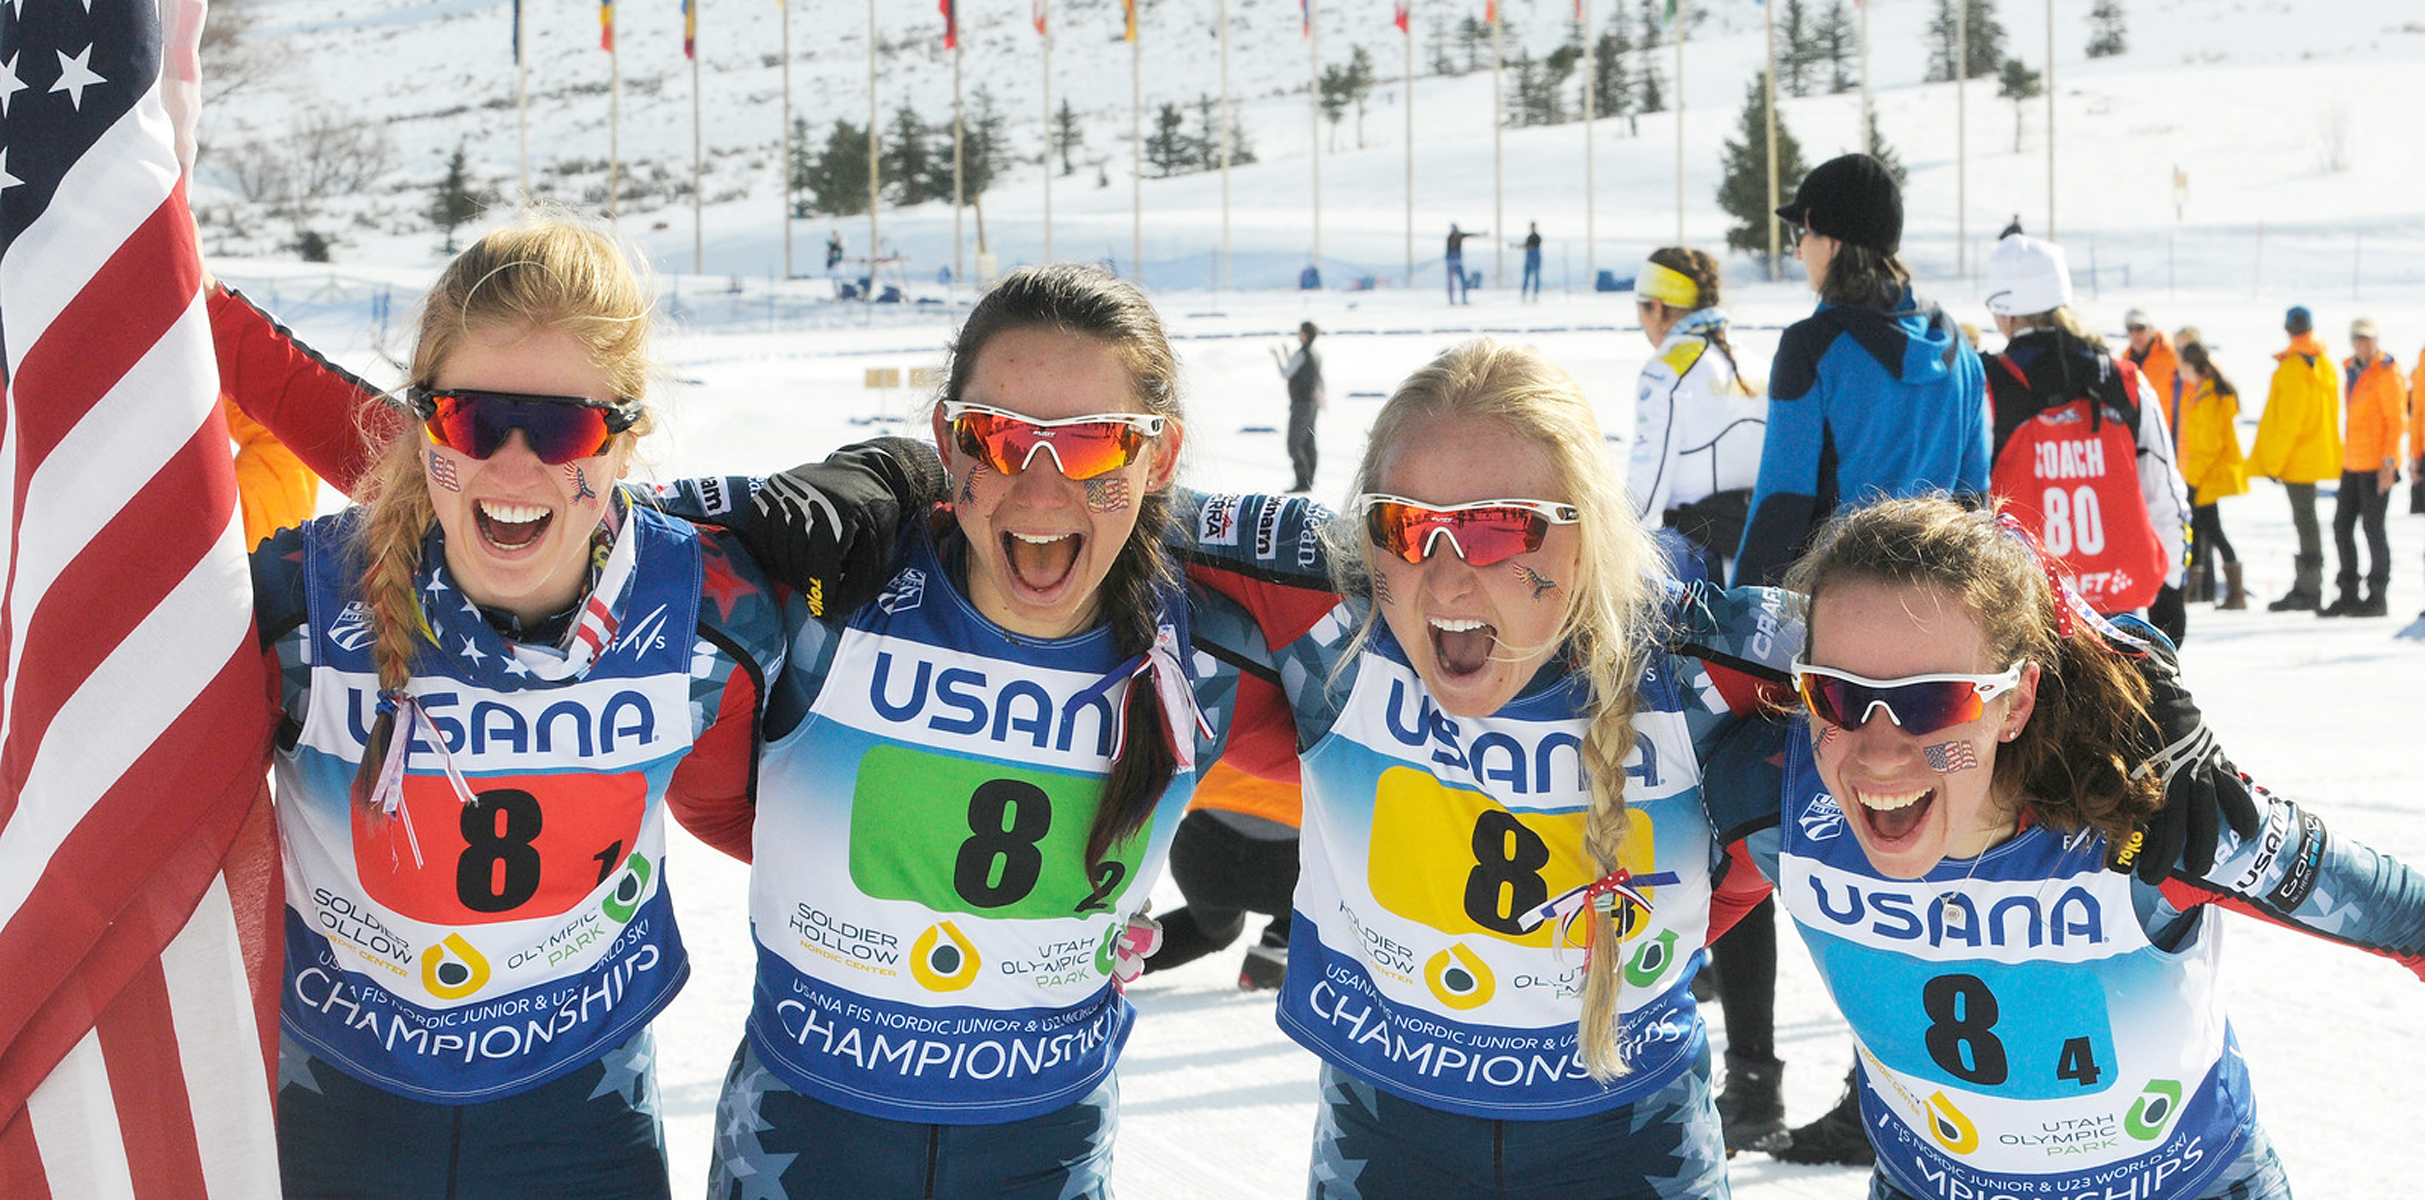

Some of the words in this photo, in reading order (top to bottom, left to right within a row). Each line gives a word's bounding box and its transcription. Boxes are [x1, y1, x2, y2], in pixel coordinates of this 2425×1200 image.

[2034, 437, 2106, 480] COACH
[2042, 485, 2106, 557] 80
[869, 651, 1113, 756] USAN
[456, 787, 543, 914] 8
[592, 839, 623, 889] 1
[953, 778, 1053, 909] 8
[1074, 860, 1126, 913] 2
[2117, 831, 2144, 867] TOKO
[1463, 808, 1550, 936] 8
[315, 906, 413, 965] OLLOW
[798, 902, 899, 950] SOLDIER
[1809, 873, 2103, 948] USANA
[547, 922, 606, 968] PARK
[789, 914, 899, 966] HOLLOW
[800, 940, 842, 964] NORDIC
[844, 958, 898, 977] CENTER
[1001, 951, 1091, 976] OLYMPIC
[1038, 937, 1096, 959] UTAH
[361, 986, 388, 1004] FIS
[461, 998, 530, 1026] JUNIOR
[534, 994, 548, 1011] &
[626, 918, 650, 945] SKI
[1035, 967, 1090, 989] PARK
[791, 977, 843, 1016] USANA
[845, 1004, 873, 1023] FIS
[875, 1010, 950, 1036] NORDIC
[953, 1018, 1021, 1036] JUNIOR
[1025, 1019, 1039, 1033] &
[1394, 1013, 1464, 1042] NORDIC
[1467, 1034, 1539, 1050] JUNIOR
[1542, 1038, 1556, 1050] &
[1921, 973, 2009, 1085] 8
[2056, 1035, 2101, 1087] 4
[1999, 1125, 2118, 1146] OLYMPIC
[2042, 1112, 2115, 1133] UTAH
[2046, 1137, 2119, 1157] PARK
[1913, 1140, 1966, 1180] NORDIC
[1969, 1174, 2035, 1192] JUNIOR
[2039, 1181, 2052, 1192] &
[2057, 1176, 2092, 1192] U23
[2095, 1153, 2163, 1185] WORLD
[2166, 1132, 2188, 1158] SKI
